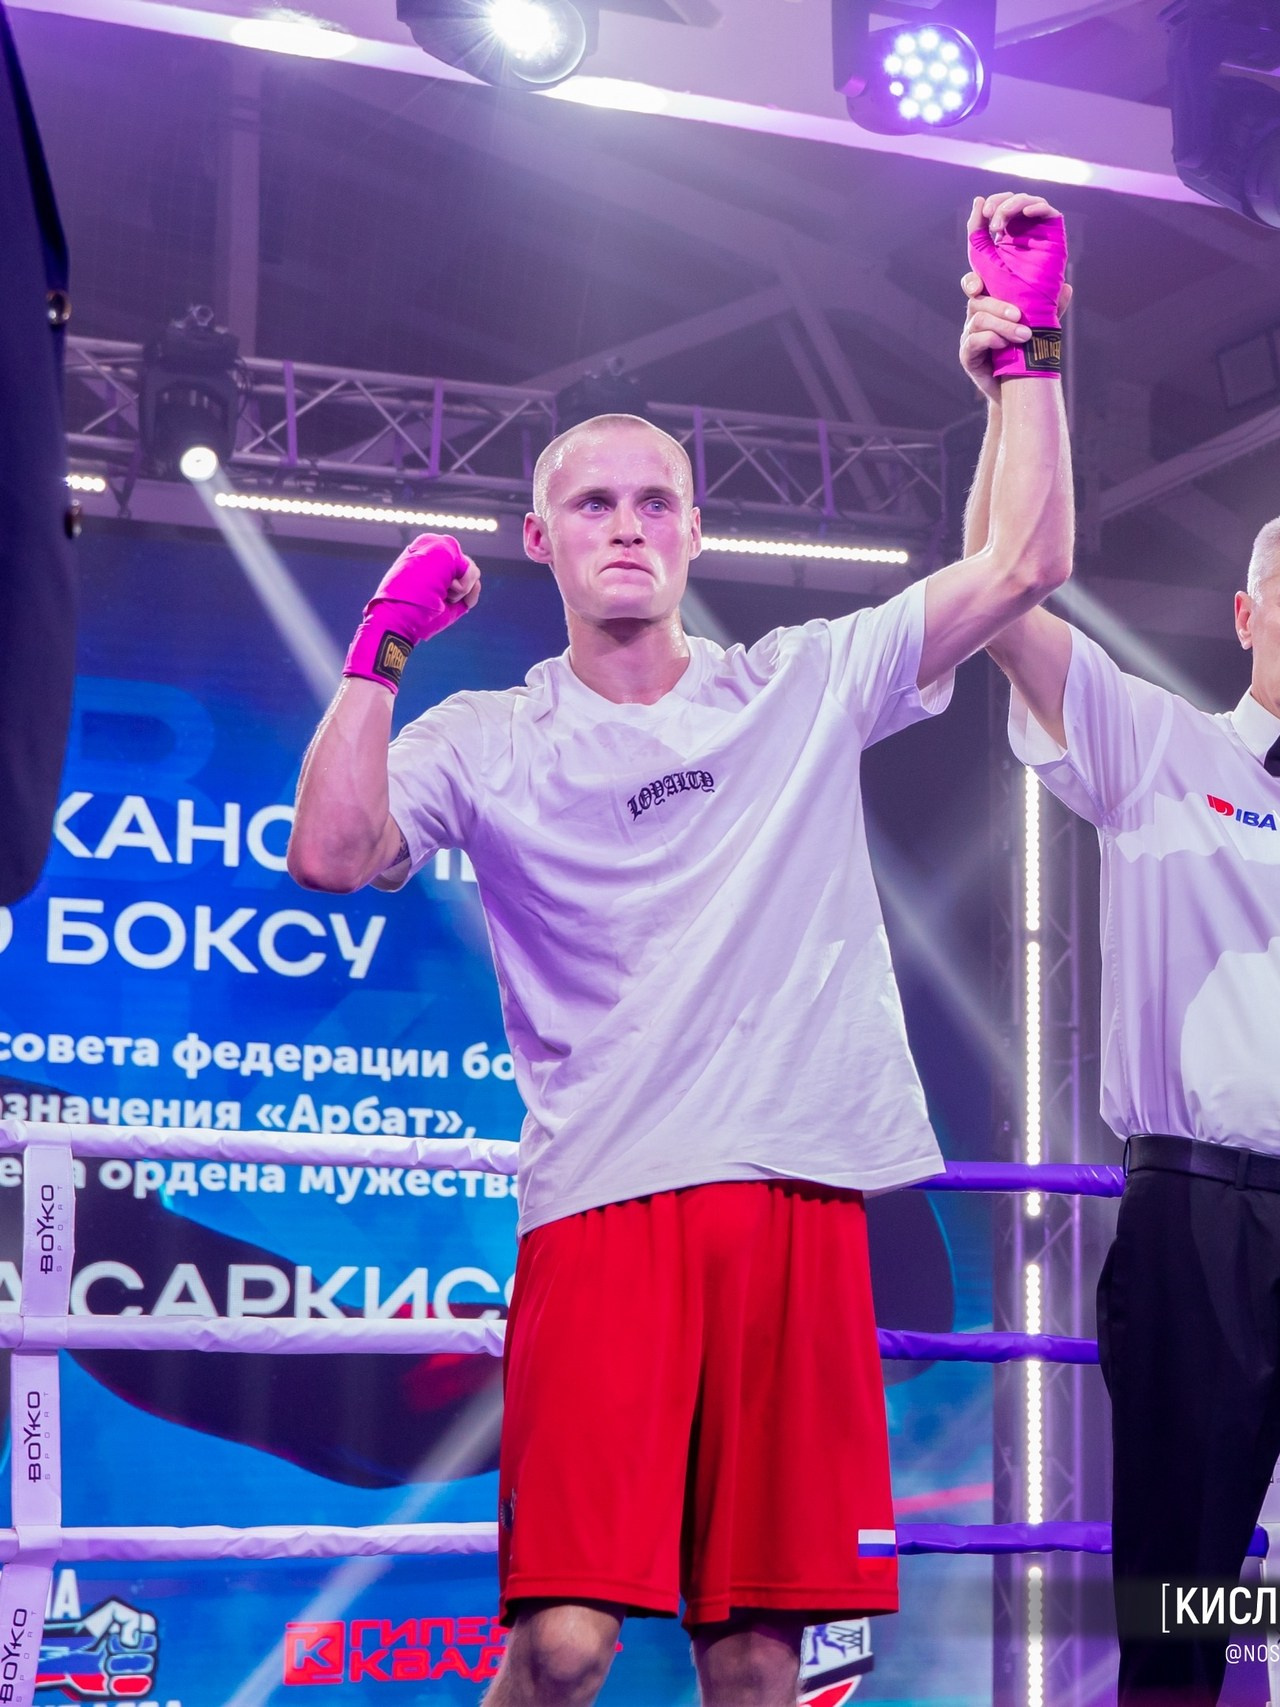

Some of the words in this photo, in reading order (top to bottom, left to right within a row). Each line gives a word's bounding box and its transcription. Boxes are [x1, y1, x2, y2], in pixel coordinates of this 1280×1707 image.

[627, 770, 716, 822] LOYALTY
[1235, 808, 1278, 831] IBA
[47, 896, 387, 979] БОКСУ
[172, 1032, 449, 1081] федерации
[0, 1093, 241, 1130] значения
[98, 1158, 286, 1199] ордена
[37, 1184, 55, 1275] BOYKO
[71, 1261, 514, 1319] САРКИС
[23, 1390, 42, 1483] BOYKO
[0, 1608, 27, 1704] BOYKO
